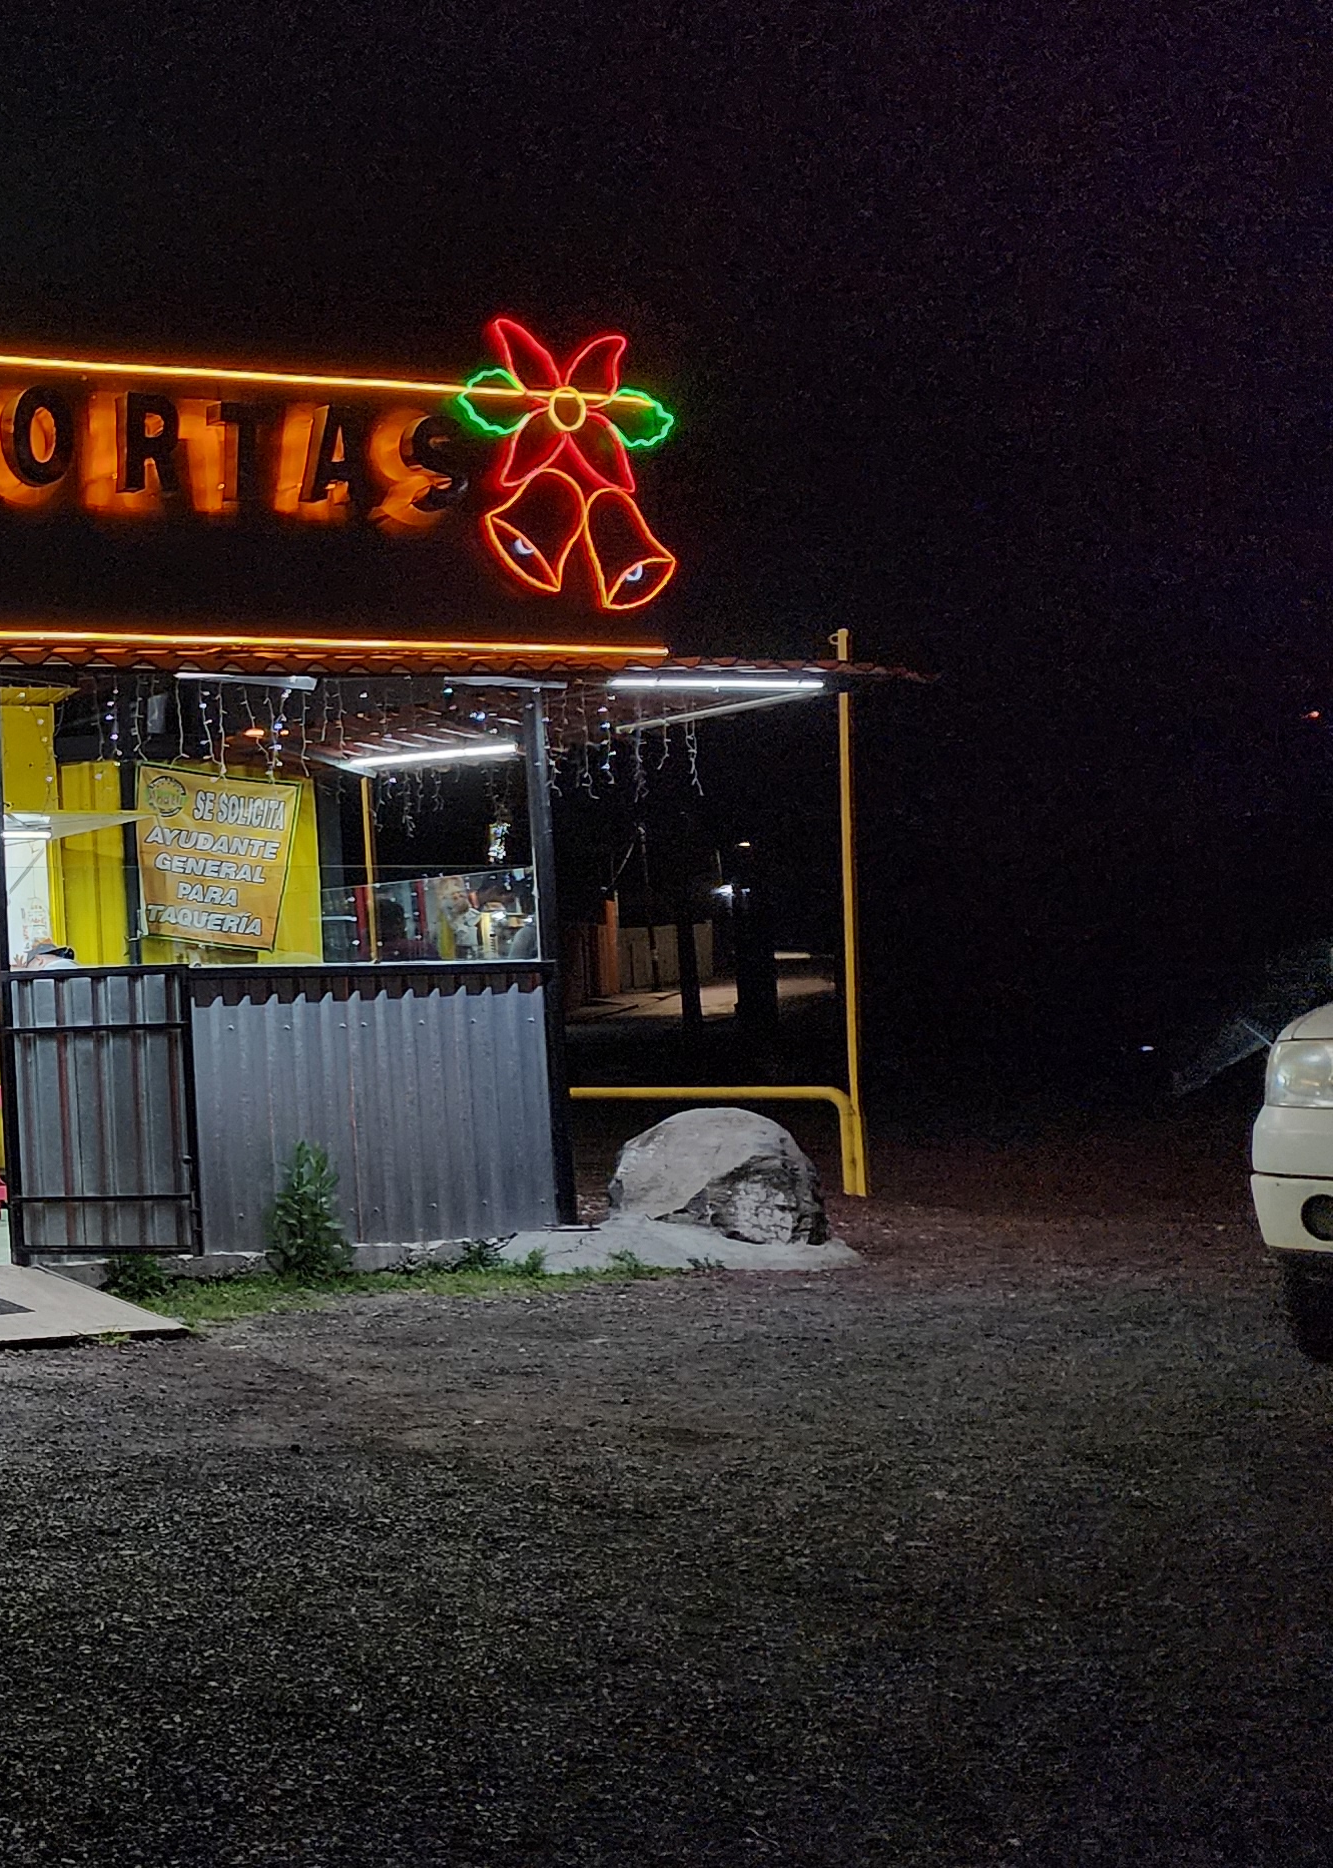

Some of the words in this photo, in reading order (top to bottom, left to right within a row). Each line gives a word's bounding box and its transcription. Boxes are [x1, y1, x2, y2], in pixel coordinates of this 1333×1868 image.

[193, 790, 214, 821] SE
[216, 794, 286, 831] SOLICITA
[145, 825, 280, 860] AYUDANTE
[154, 852, 266, 883] GENERAL
[176, 881, 239, 907] PARA
[147, 904, 263, 936] TAQUERÍA
